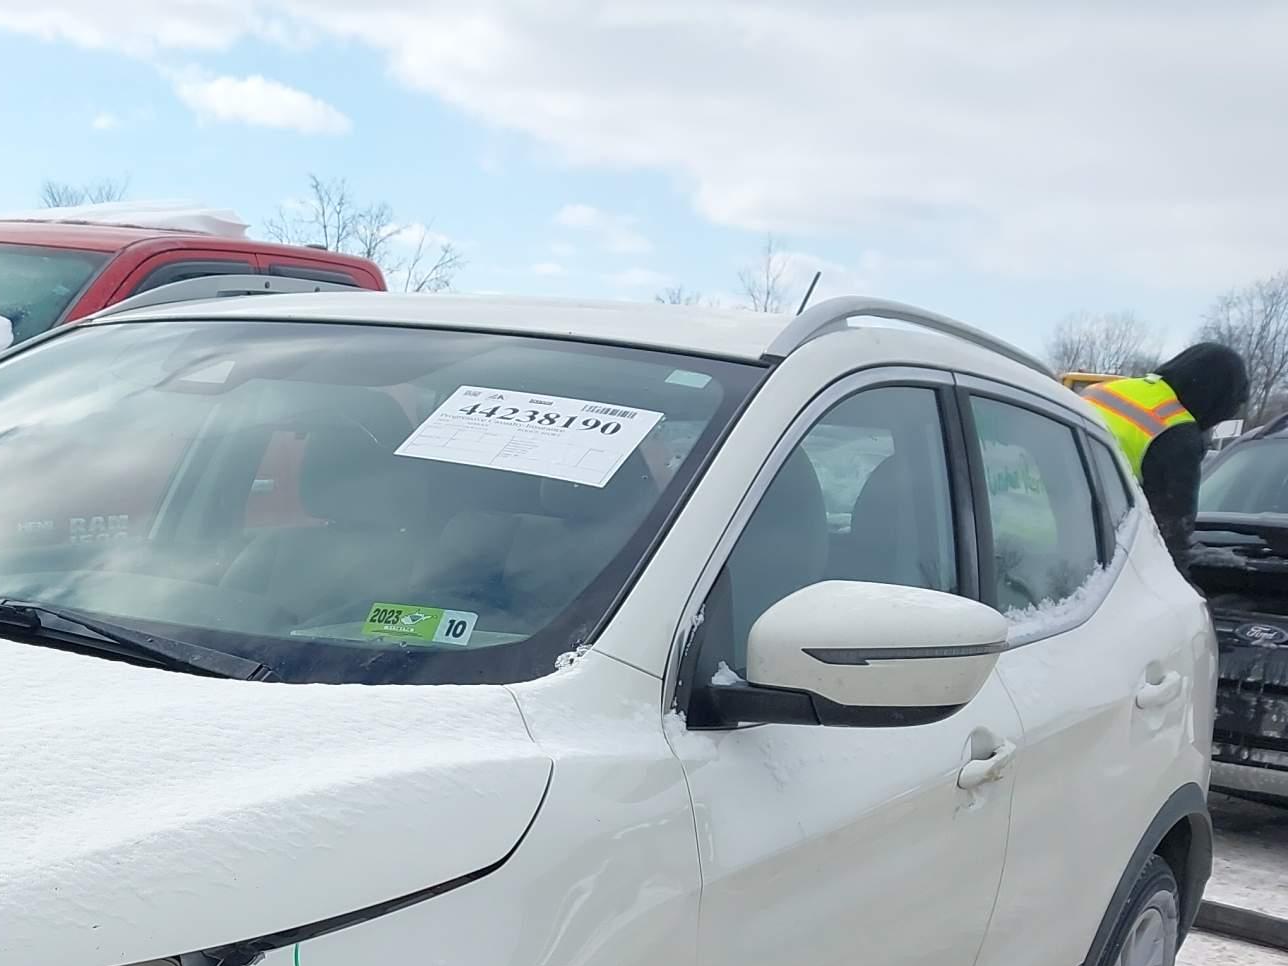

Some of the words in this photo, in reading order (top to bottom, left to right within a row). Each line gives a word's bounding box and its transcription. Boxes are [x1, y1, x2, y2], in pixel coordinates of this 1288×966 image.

[458, 403, 622, 436] 44238190
[369, 607, 403, 625] 2023
[445, 619, 468, 638] 10
[1246, 625, 1278, 639] Ford
